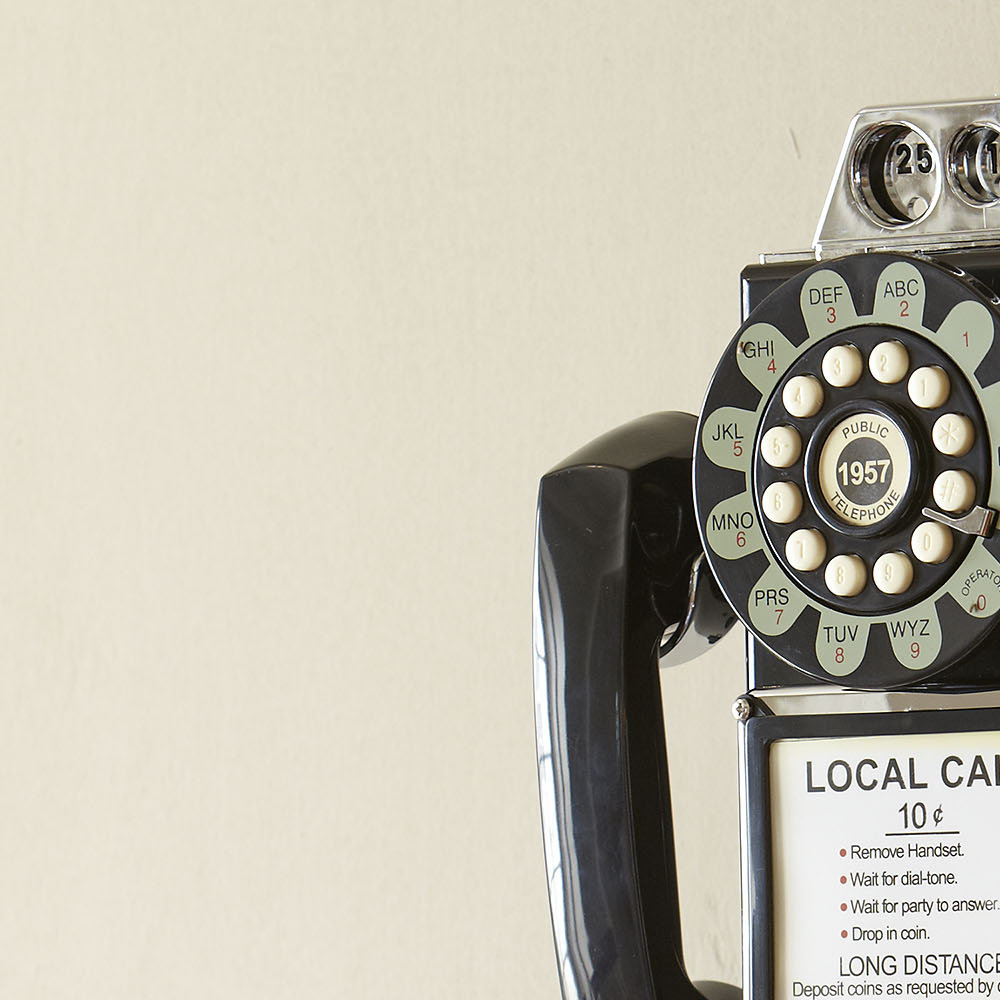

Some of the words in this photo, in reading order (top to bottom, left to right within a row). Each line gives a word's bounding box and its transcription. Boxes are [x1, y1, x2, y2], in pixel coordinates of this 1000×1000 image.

[895, 142, 933, 175] 25
[809, 286, 843, 305] DEF
[883, 279, 919, 298] ABC
[827, 307, 837, 323] 3
[900, 301, 909, 317] 2
[963, 331, 970, 347] 1
[743, 341, 774, 359] GHI
[767, 359, 777, 374] 4
[712, 423, 744, 441] JKL
[842, 421, 889, 440] PUBLIC
[733, 441, 743, 457] 5
[838, 459, 891, 486] 1957
[831, 489, 901, 521] TELEPHONE
[712, 512, 753, 531] MNO
[737, 531, 747, 547] 6
[755, 588, 789, 607] PRS
[977, 595, 987, 611] 0
[774, 609, 784, 625] 7
[823, 625, 859, 643] TUV
[890, 619, 930, 638] WYZ
[835, 648, 844, 663] 8
[910, 643, 920, 658] 9
[806, 758, 928, 793] LOCAL
[851, 845, 904, 859] Remove
[908, 842, 964, 858] Handset.
[850, 871, 879, 887] Wait
[882, 871, 898, 886] for
[901, 870, 958, 885] dial-tone.
[851, 899, 879, 914] Wait
[882, 898, 898, 913] for
[902, 898, 933, 916] party
[937, 898, 949, 912] to
[952, 899, 1000, 912] answer.
[852, 926, 883, 944] Drop
[887, 926, 898, 940] in
[901, 926, 930, 940] coin.
[839, 955, 897, 977] LONG
[792, 981, 844, 1000] Deposit
[848, 981, 883, 996] coins
[887, 983, 903, 995] as
[906, 979, 974, 998] requested
[978, 978, 994, 996] by
